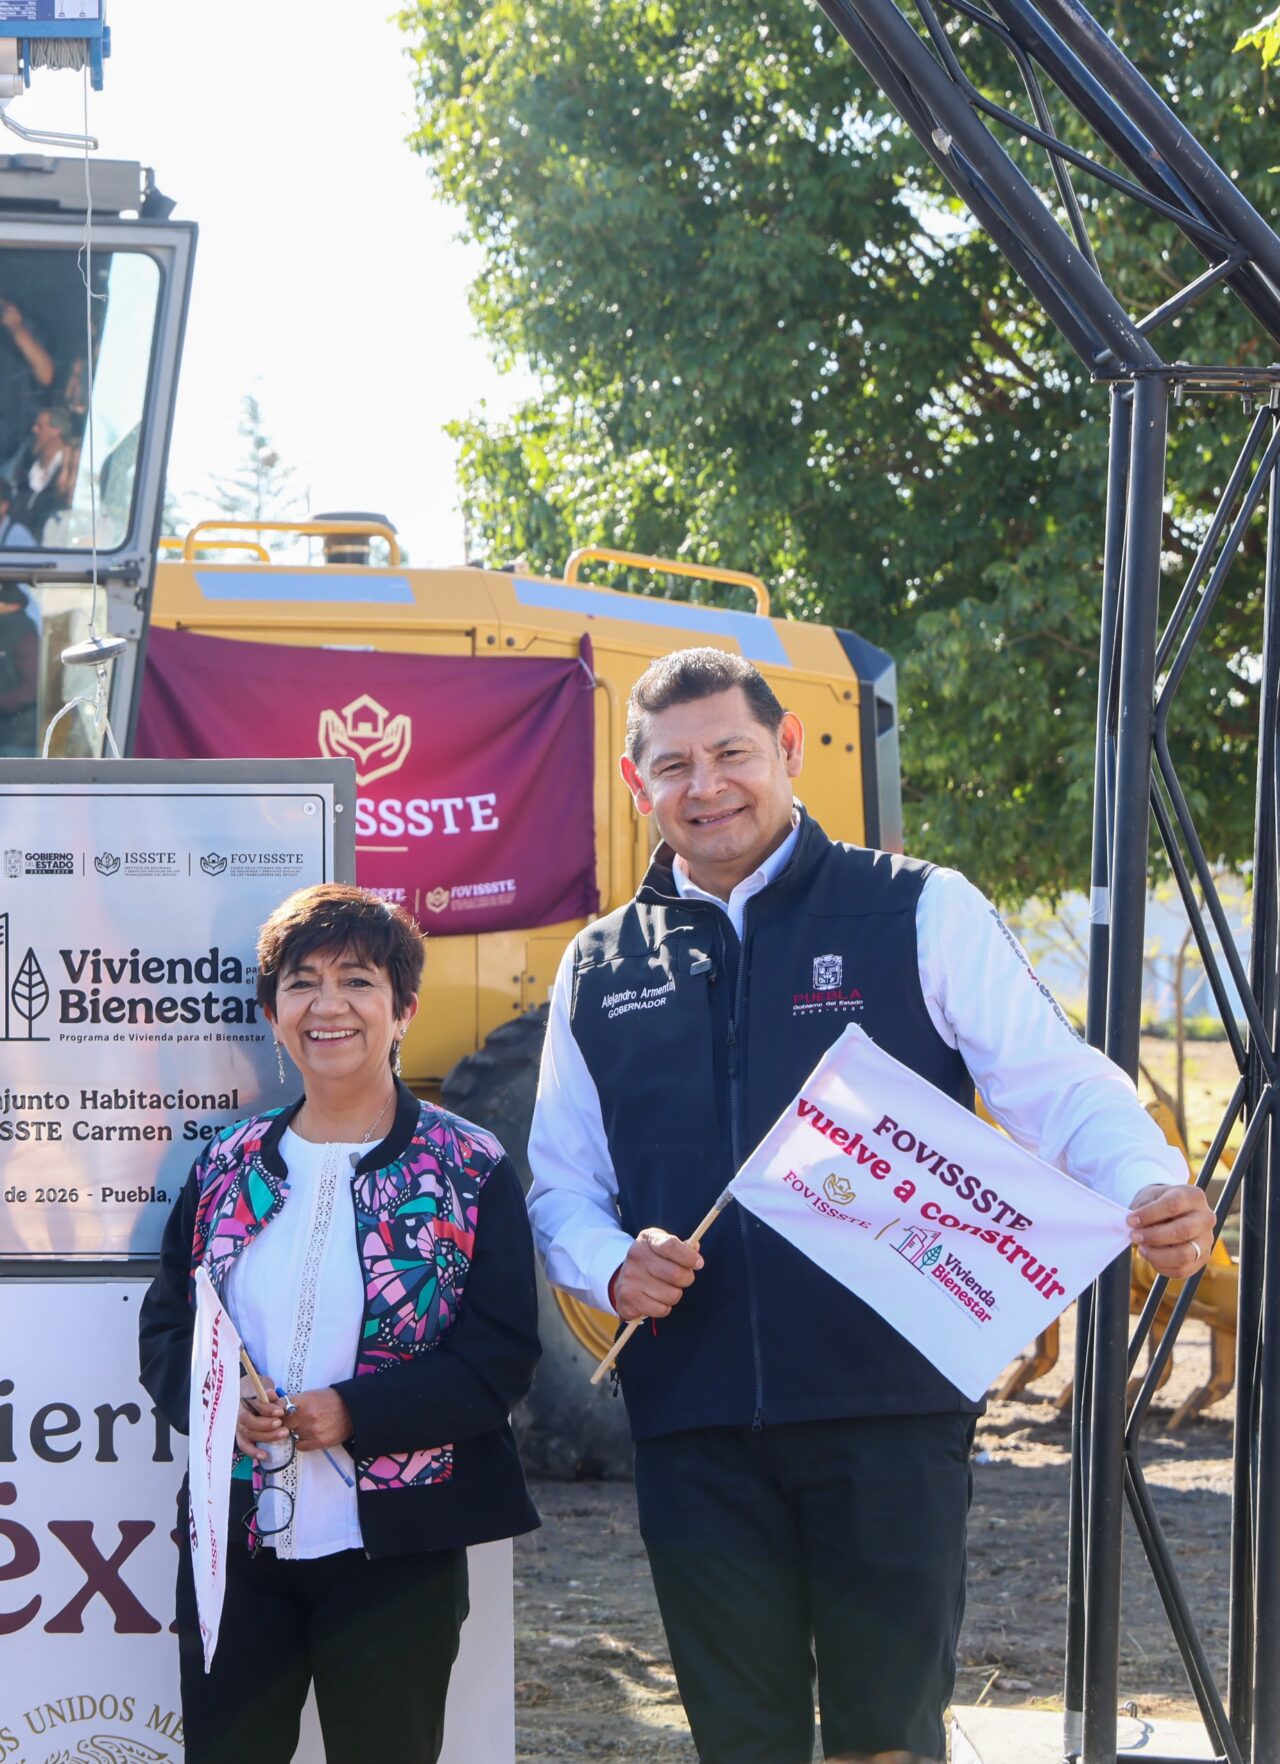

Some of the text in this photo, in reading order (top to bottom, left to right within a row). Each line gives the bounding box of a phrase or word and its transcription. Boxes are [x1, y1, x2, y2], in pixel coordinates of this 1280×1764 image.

[354, 792, 500, 837] SSSTE
[25, 853, 74, 861] GOBIERNO
[36, 861, 74, 869] ESTADO
[124, 852, 176, 864] ISSSTE
[230, 853, 304, 864] FOVISSSTE
[59, 947, 242, 984] Vivienda
[245, 977, 254, 985] el
[59, 988, 260, 1024] Bienestar
[602, 981, 675, 1009] Alejandro Armenta
[793, 988, 862, 1004] PUEBLA
[608, 997, 667, 1019] GOBERNADOR
[59, 1033, 266, 1043] Programa de Vivienda para el Bienestar
[80, 1089, 239, 1110] Habitacional
[72, 1121, 172, 1141] Carmen
[872, 1115, 1033, 1231] FOVISSSTE
[4, 1187, 27, 1203] de
[35, 1188, 78, 1203] 2026
[101, 1187, 171, 1205] Puebla,
[783, 1170, 871, 1229] FOVISSSTE
[796, 1098, 1065, 1300] vuelve a construir
[944, 1253, 996, 1308] Vivienda
[931, 1263, 992, 1323] Bienestar
[22, 1694, 136, 1734] UNIDOS
